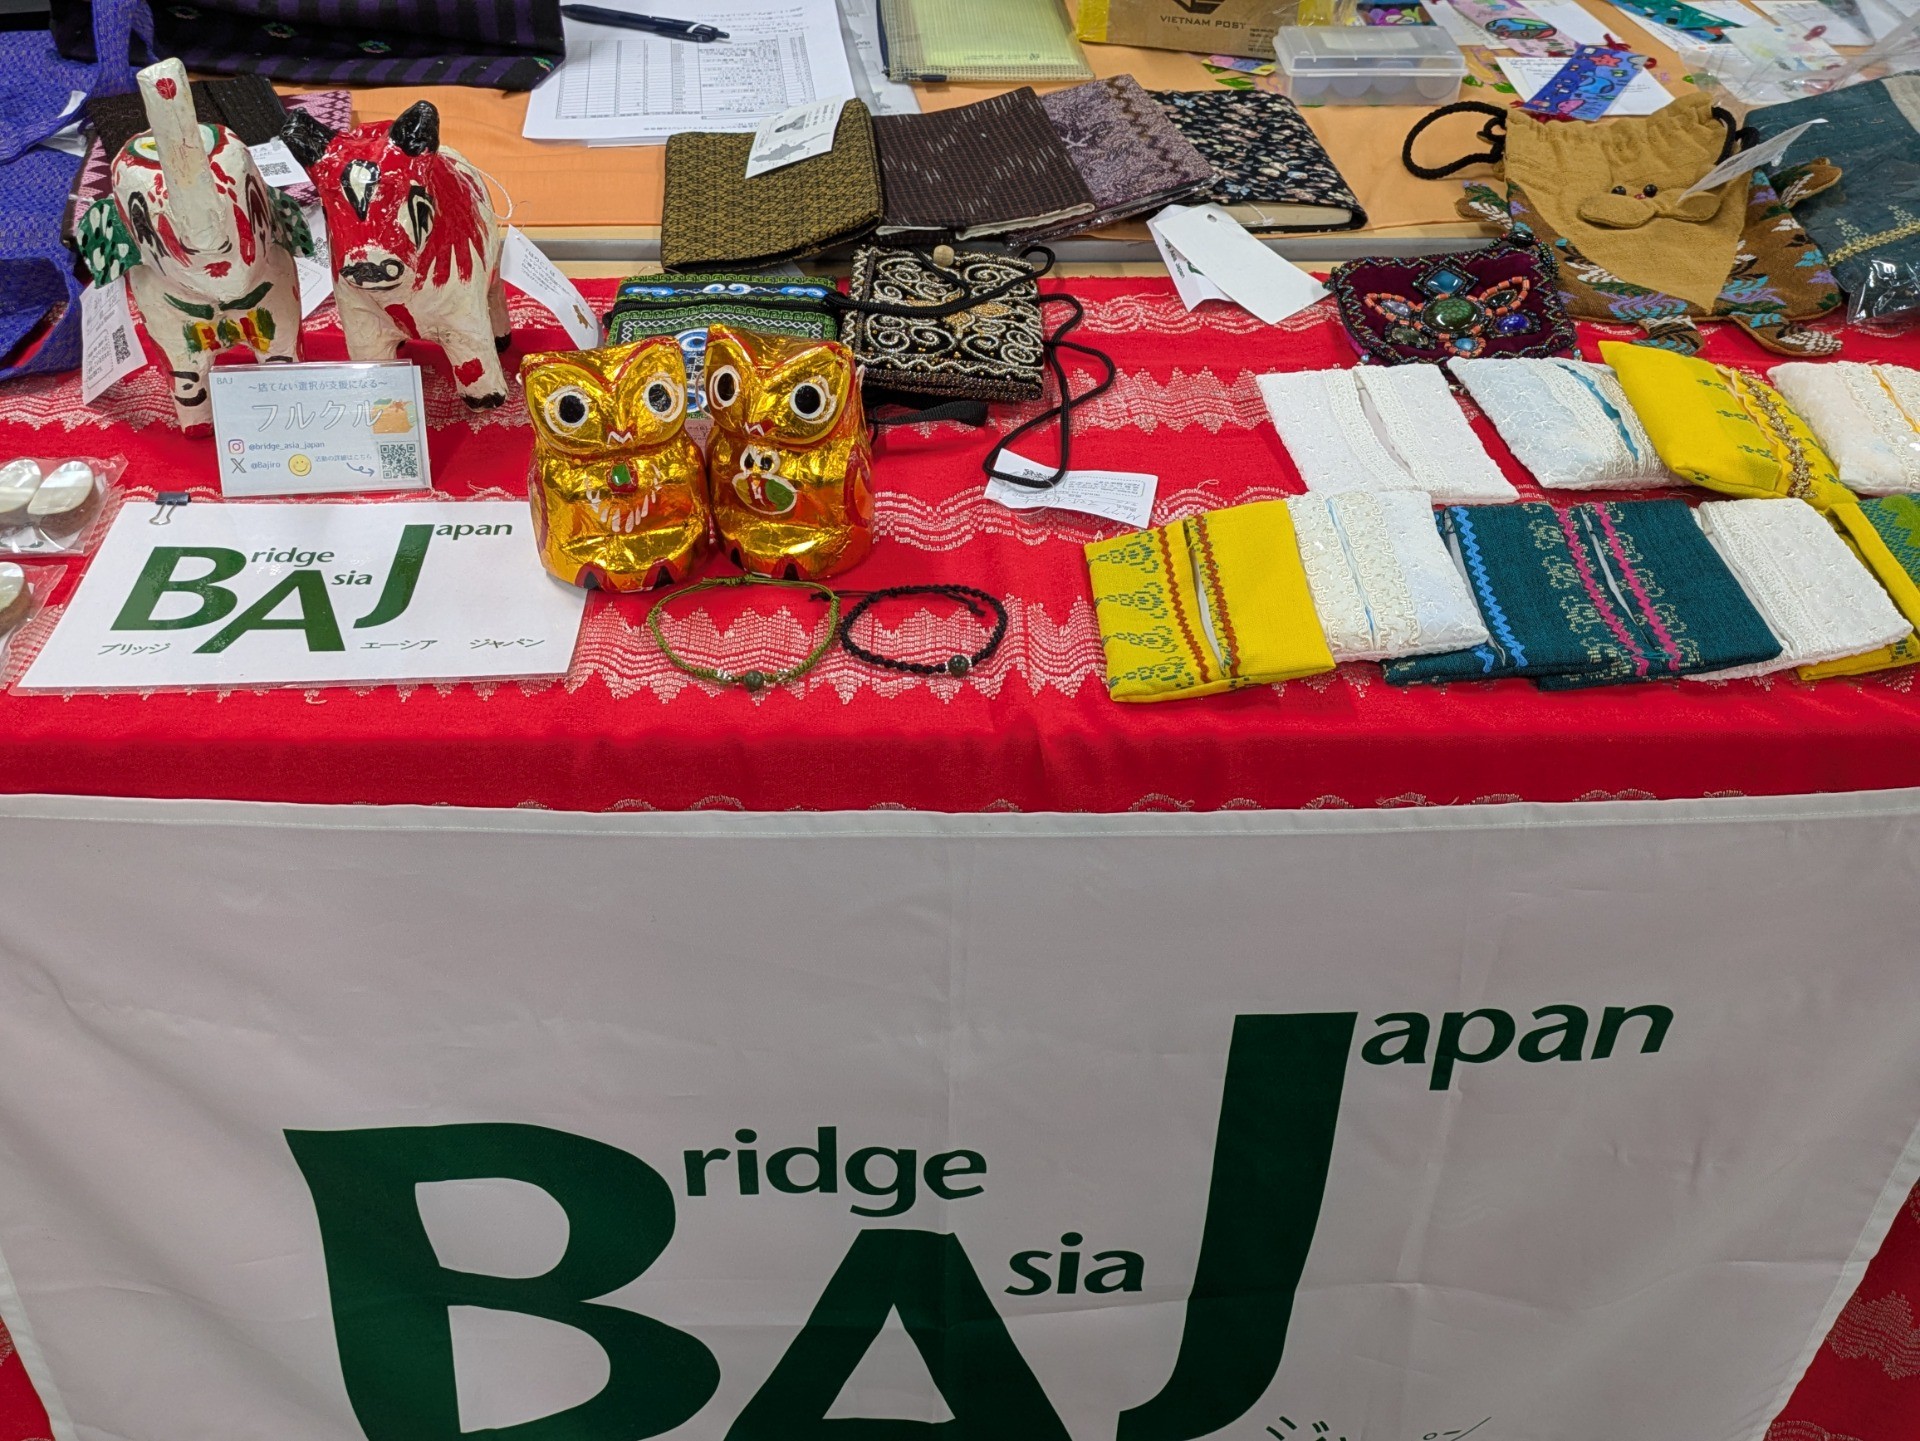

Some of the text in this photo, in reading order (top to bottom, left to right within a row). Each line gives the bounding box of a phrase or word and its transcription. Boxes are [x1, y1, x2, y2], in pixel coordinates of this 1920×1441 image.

[1160, 15, 1247, 30] VIETNAM POST
[216, 377, 233, 385] BAJ
[251, 399, 384, 432] フルクル
[248, 441, 325, 451] @bridge_asia_japan
[250, 461, 281, 470] @Bajiro
[98, 643, 171, 655] ブリッジ
[360, 640, 438, 650] エーシア
